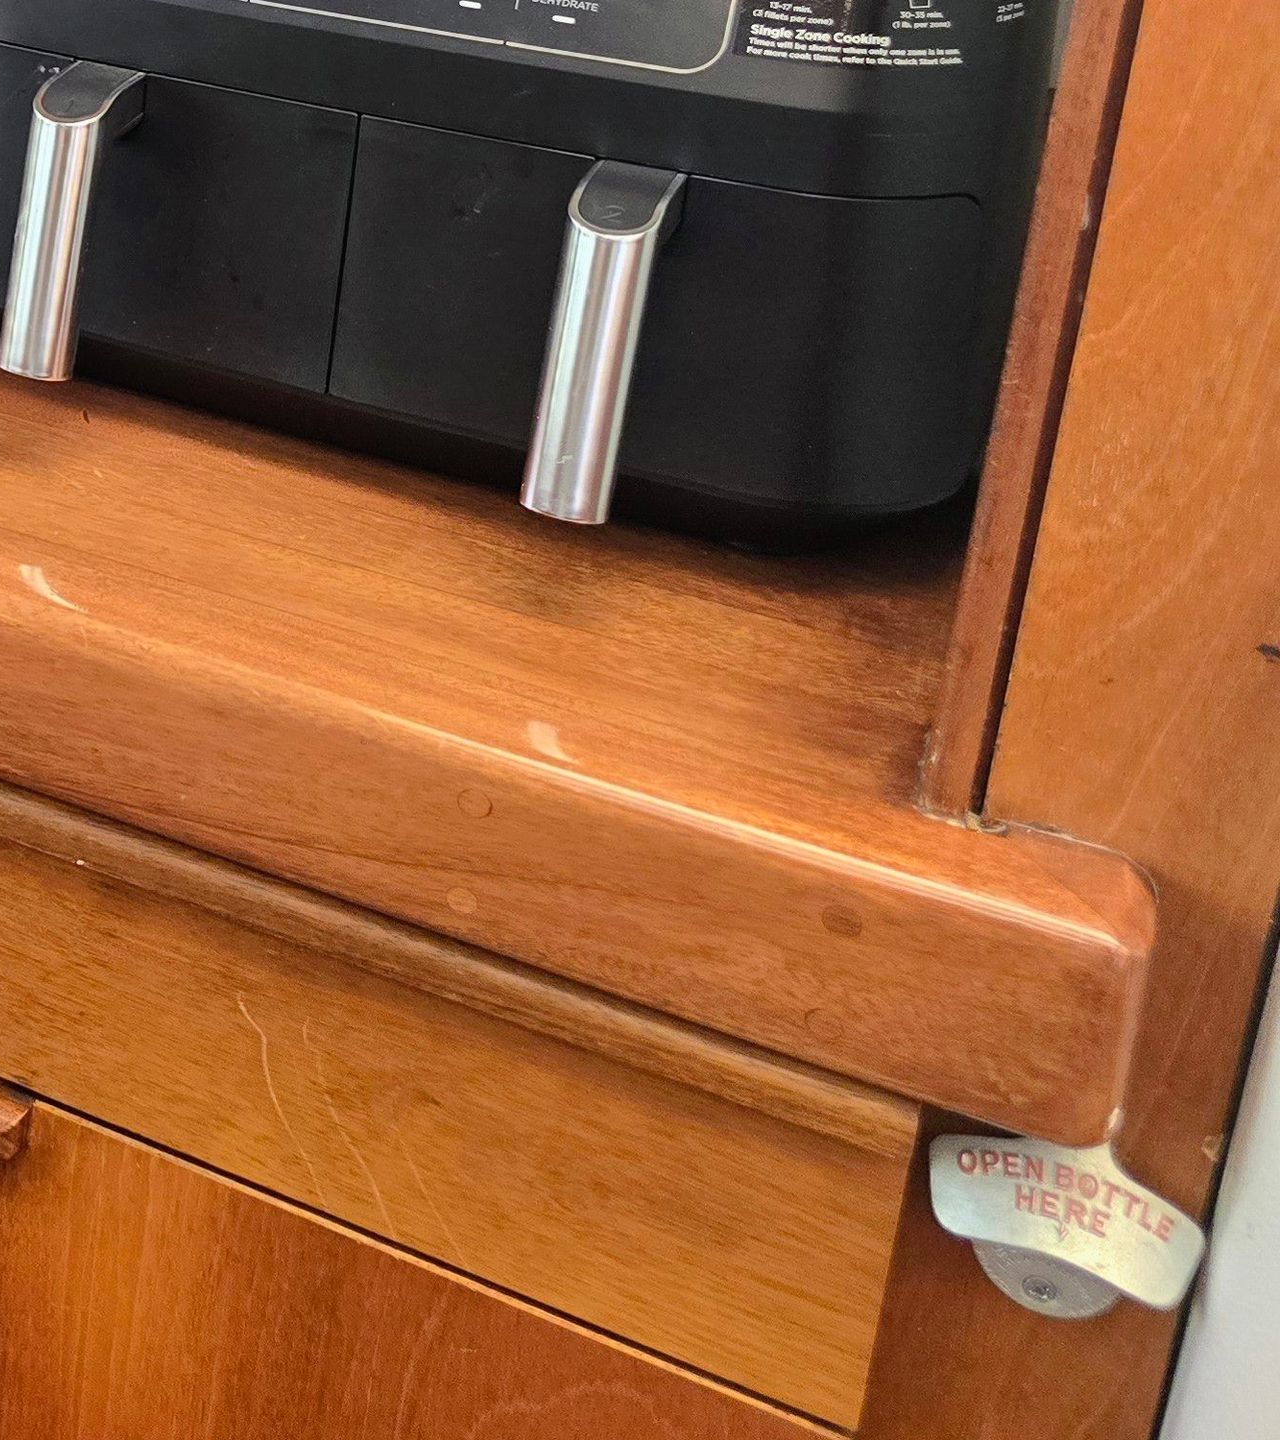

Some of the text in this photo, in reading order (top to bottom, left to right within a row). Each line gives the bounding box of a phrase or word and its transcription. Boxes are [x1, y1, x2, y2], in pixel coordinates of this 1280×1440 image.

[793, 6, 813, 14] min.
[789, 15, 807, 23] per
[806, 18, 834, 26] zone)
[913, 21, 929, 29] per
[750, 23, 890, 47] Single Zone Cooking
[746, 46, 763, 55] For
[763, 49, 788, 58] more
[788, 52, 813, 61] cook
[748, 37, 776, 47] Times
[776, 41, 794, 49] will
[794, 42, 807, 51] be
[808, 44, 842, 53] shorter
[842, 46, 868, 55] when
[868, 47, 889, 56] only
[956, 1148, 1176, 1244] OPEN BOTTLE
[1013, 1183, 1111, 1239] HERE
